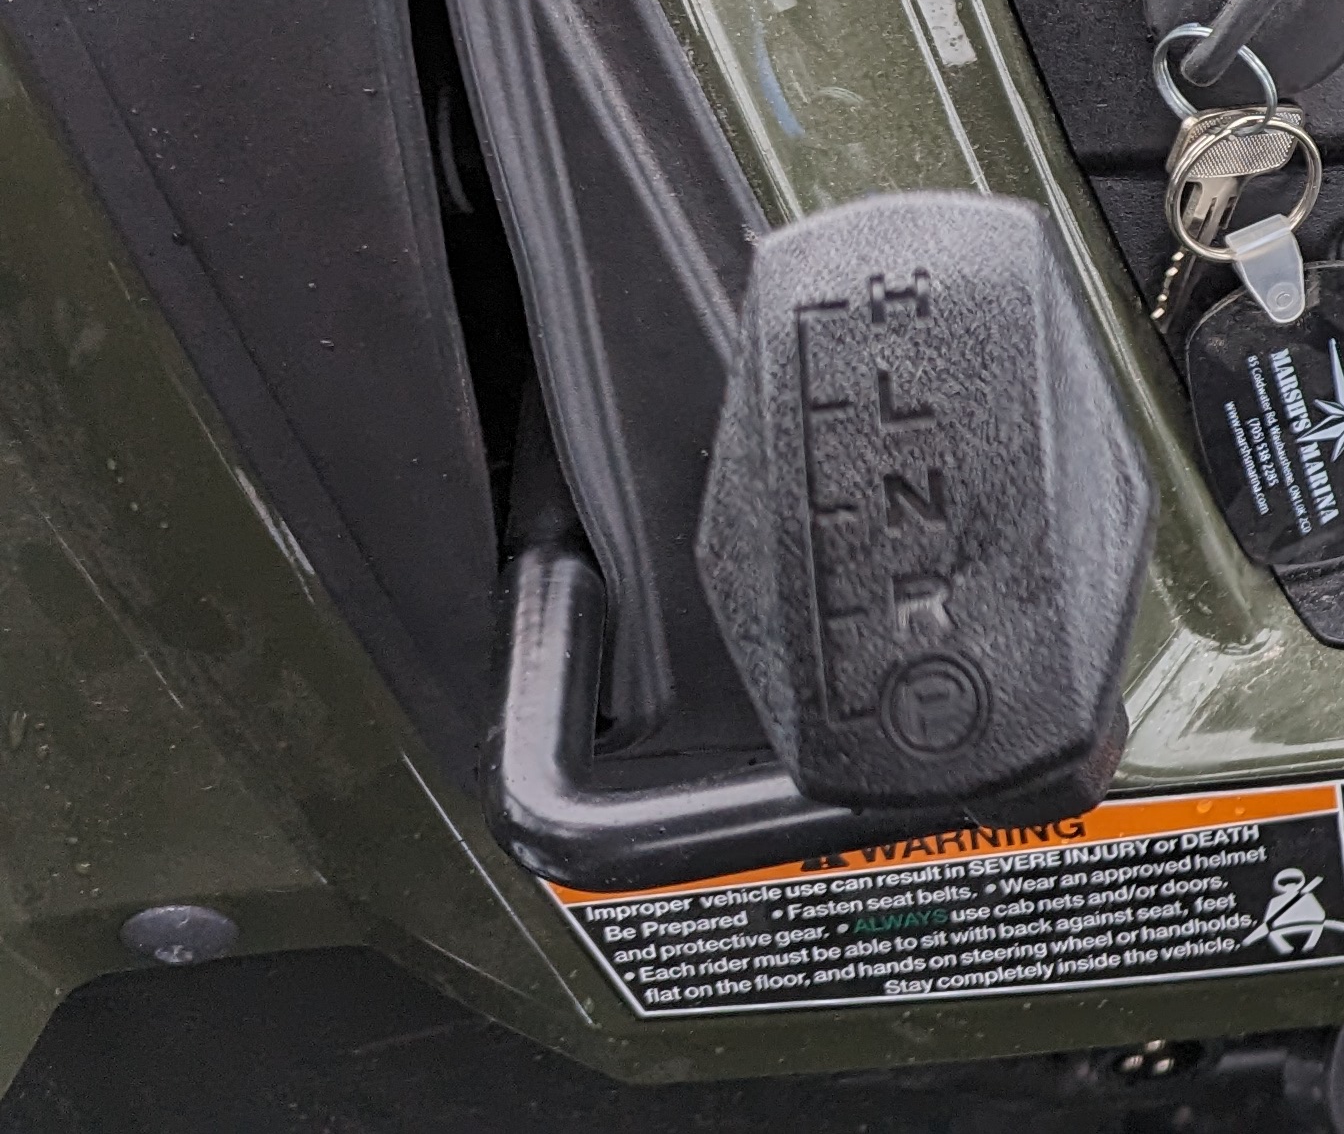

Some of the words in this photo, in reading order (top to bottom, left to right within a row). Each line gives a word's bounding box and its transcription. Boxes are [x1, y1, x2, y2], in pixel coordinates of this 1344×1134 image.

[869, 268, 931, 323] H
[1248, 355, 1259, 367] 85
[1252, 368, 1272, 411] Coldwater
[876, 368, 936, 429] L
[1226, 401, 1269, 514] www.marshsmarina.com
[1247, 418, 1264, 442] (705)
[1257, 443, 1279, 486] 538-2285
[1270, 348, 1311, 433] MARSH'S
[1300, 442, 1339, 524] MARINA
[885, 468, 946, 531] N
[1289, 485, 1301, 501] ON
[893, 571, 953, 631] R
[861, 816, 1087, 862] WARNING
[586, 897, 692, 921] Improper
[700, 885, 781, 908] vehicle
[785, 882, 826, 898] use
[830, 876, 872, 892] can
[876, 865, 941, 887] result
[944, 863, 965, 879] in
[966, 848, 1062, 876] SEVERE
[1064, 838, 1150, 864] INJURY
[1154, 838, 1177, 852] or
[1178, 821, 1260, 849] DEATH
[604, 925, 636, 942] Be
[640, 910, 748, 937] Prepared
[788, 899, 863, 920] Fasten
[866, 890, 914, 910] seat
[916, 885, 977, 905] belts.
[999, 875, 1057, 895] Wear
[1060, 872, 1087, 887] an
[1090, 855, 1191, 884] approved
[1194, 845, 1266, 869] helmet
[883, 978, 934, 998] Stay
[936, 961, 1054, 988] completely
[1057, 952, 1120, 974] inside
[1123, 948, 1158, 964] the
[1160, 938, 1240, 960] vehicle.
